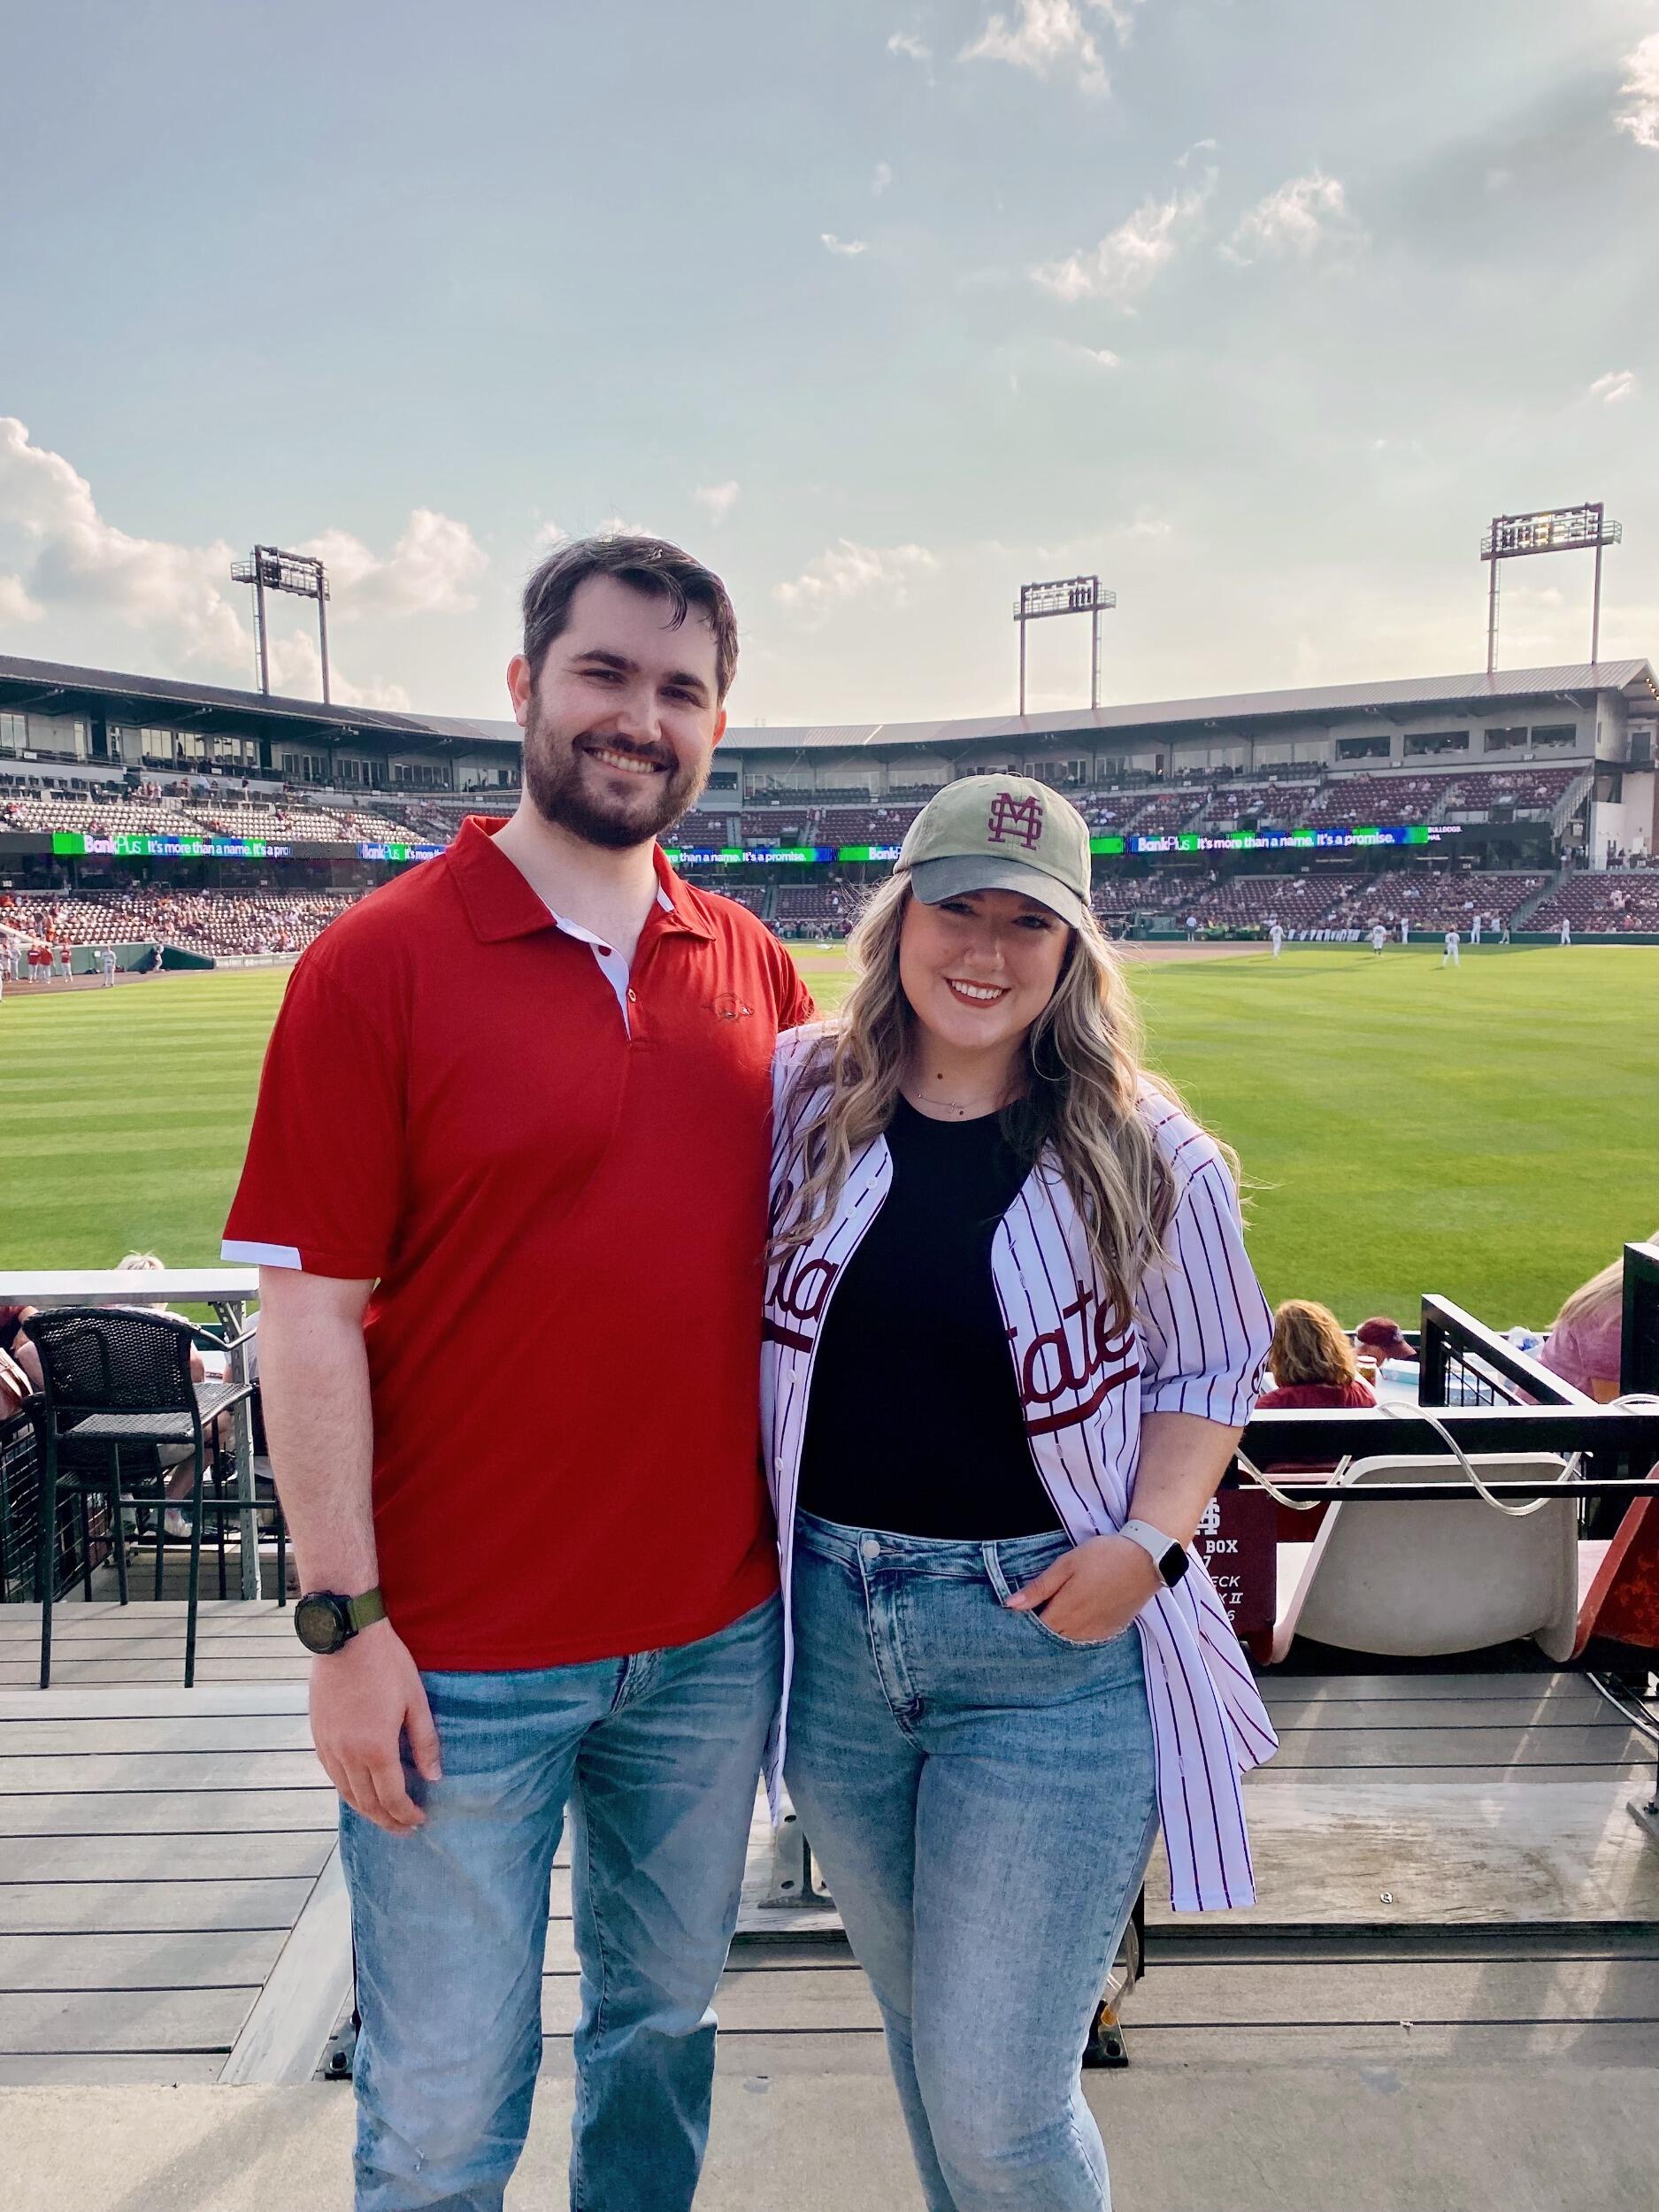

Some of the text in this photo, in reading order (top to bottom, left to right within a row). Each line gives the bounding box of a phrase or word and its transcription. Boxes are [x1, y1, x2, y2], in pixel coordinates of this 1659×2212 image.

[84, 834, 142, 854] BankPlus
[147, 840, 164, 854] It's
[165, 843, 192, 854] more
[192, 841, 215, 855] than
[216, 845, 224, 855] a
[224, 846, 252, 856] name.
[267, 846, 273, 856] a
[274, 846, 291, 858] pro
[1138, 836, 1190, 852] BankPlus
[1197, 837, 1213, 850] It's
[1214, 839, 1242, 849] more
[1244, 836, 1269, 849] than
[1279, 837, 1315, 848] name.
[1317, 833, 1333, 846] It's
[1335, 835, 1343, 845] a
[1344, 832, 1395, 847] promise.
[680, 852, 702, 863] than
[703, 854, 710, 863] a
[742, 852, 757, 863] It's
[757, 854, 764, 863] a
[765, 851, 807, 864] promise.
[869, 846, 902, 861] BankP
[1205, 1540, 1239, 1554] BOX
[1203, 1555, 1212, 1571] 7
[1210, 1576, 1241, 1588] ECK
[1229, 1592, 1244, 1604] II
[1227, 1610, 1236, 1622] 6
